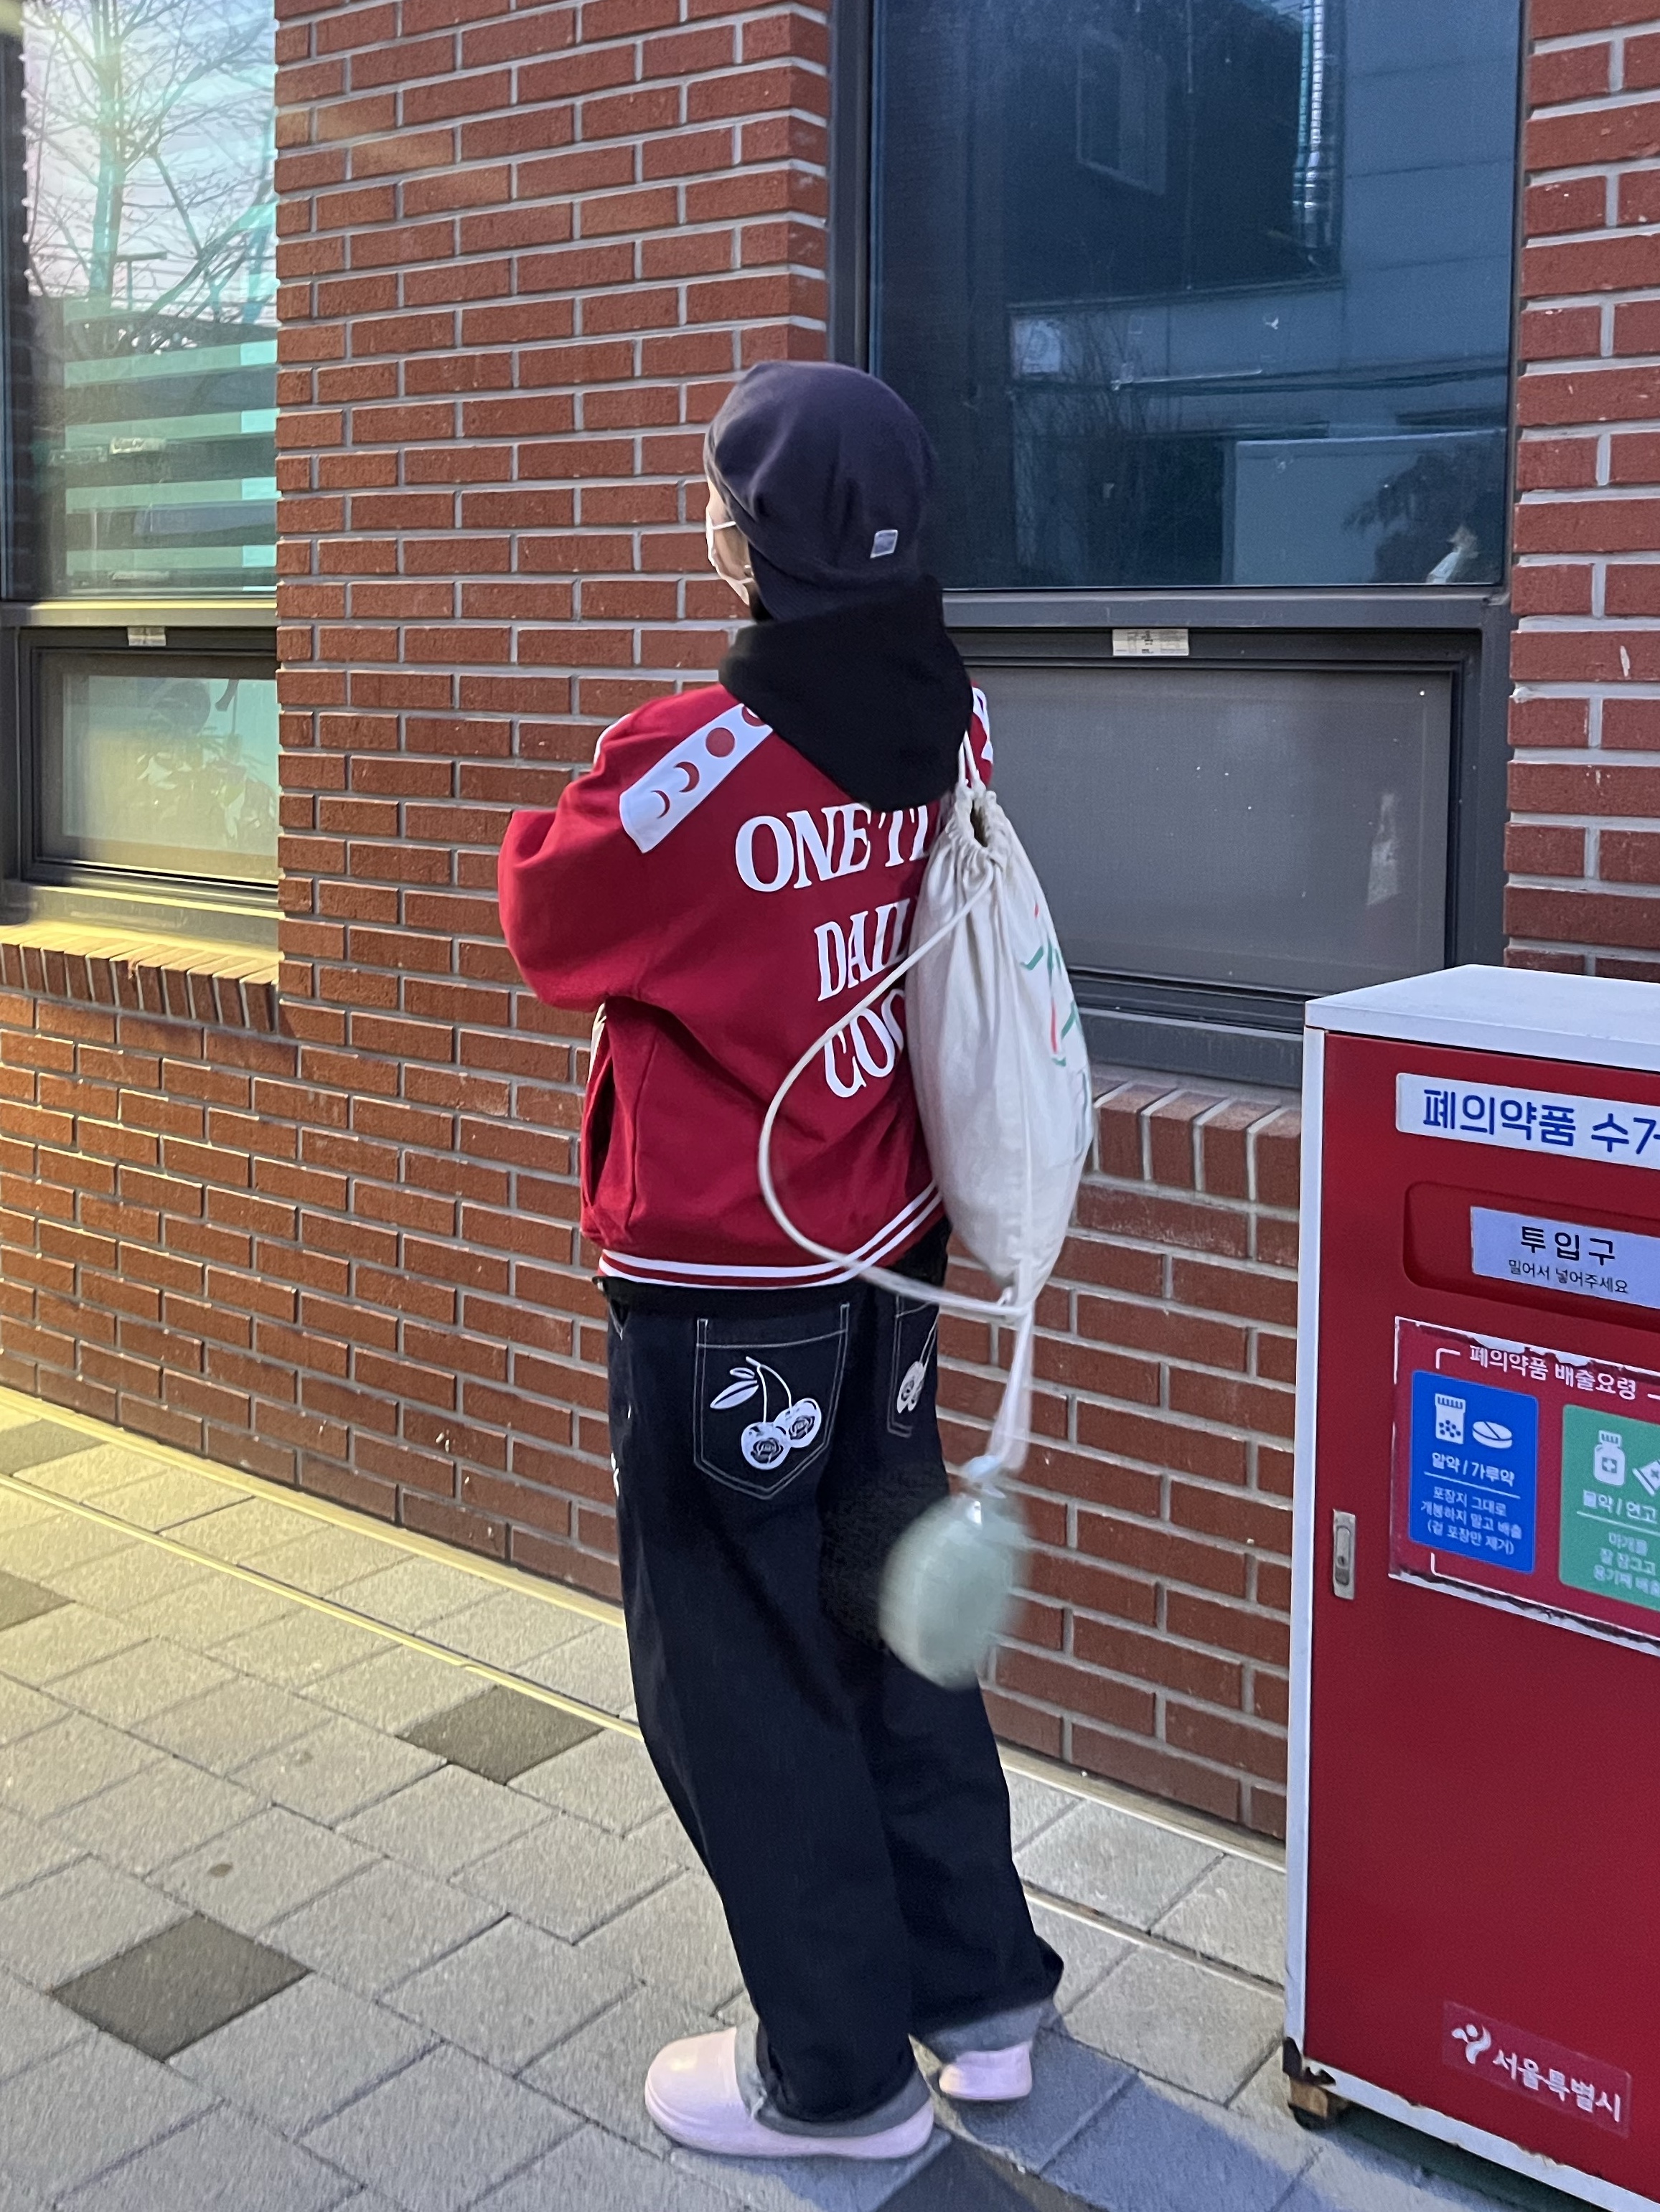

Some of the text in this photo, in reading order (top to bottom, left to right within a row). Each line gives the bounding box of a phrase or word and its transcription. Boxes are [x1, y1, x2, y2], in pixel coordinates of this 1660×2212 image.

[735, 803, 871, 893] ONE
[1423, 1089, 1576, 1147] 폐의약품
[1521, 1225, 1616, 1266] 투입구
[1509, 1259, 1628, 1294] 밀어서 넣어주세요
[1469, 1345, 1636, 1401] 폐의약품 배출요령
[1432, 1452, 1460, 1474] 알약
[1471, 1462, 1515, 1487] 가루약
[1432, 1486, 1508, 1517] 포장지 그대로
[1626, 1501, 1658, 1525] 연고
[1446, 1524, 1483, 1547] 포장만
[1492, 2048, 1622, 2124] 서울특별시
